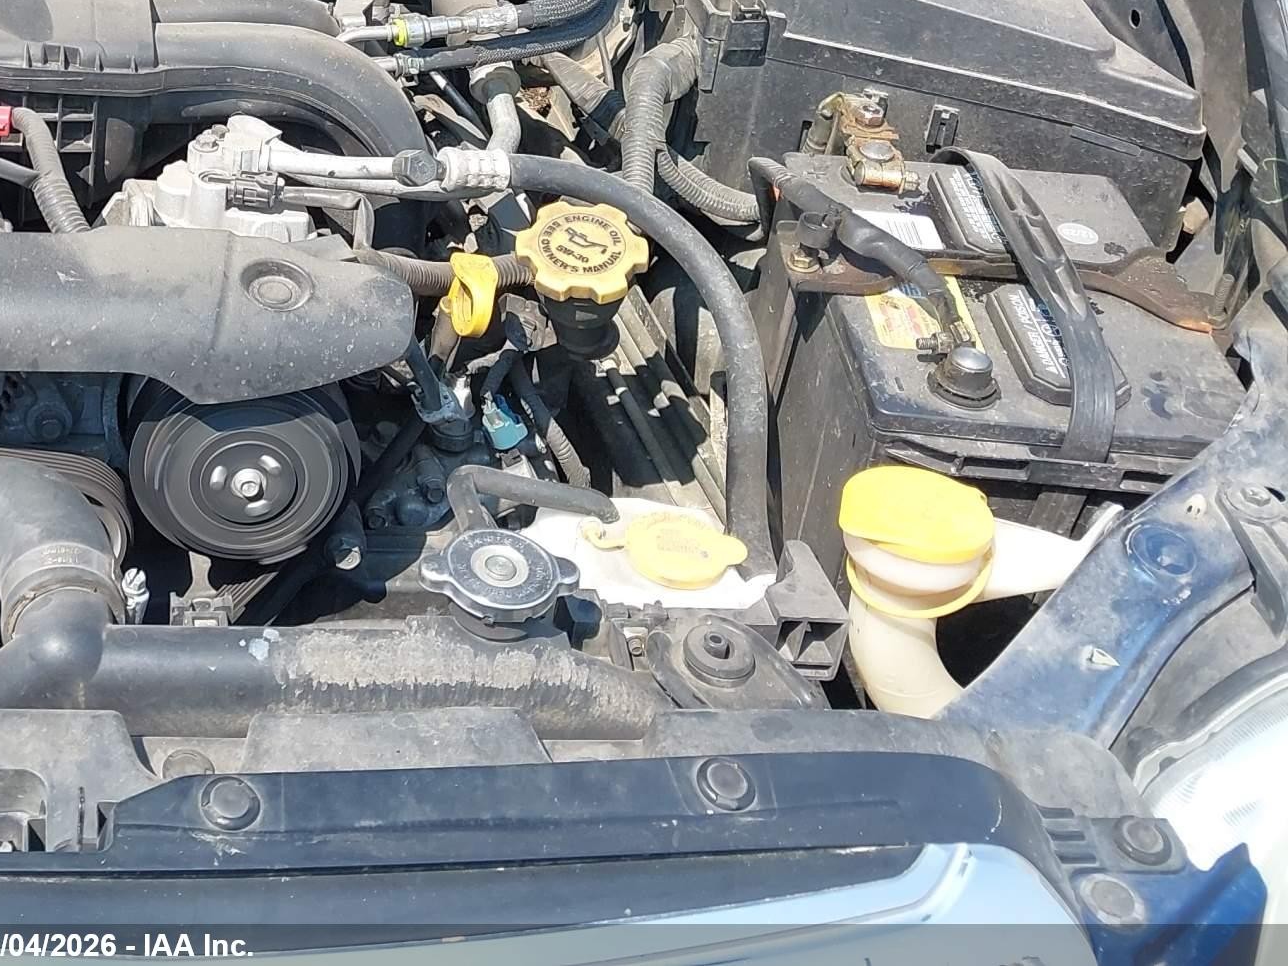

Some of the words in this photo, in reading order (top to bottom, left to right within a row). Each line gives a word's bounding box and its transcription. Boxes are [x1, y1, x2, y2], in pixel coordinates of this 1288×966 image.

[543, 220, 562, 236] SEE
[564, 215, 612, 231] ENGINE
[609, 230, 622, 246] OIL
[540, 238, 579, 273] OWNER'S
[555, 244, 589, 263] 5W-30
[582, 250, 622, 274] MANUAL
[1008, 293, 1033, 324] POISON
[1027, 331, 1055, 367] DANGER
